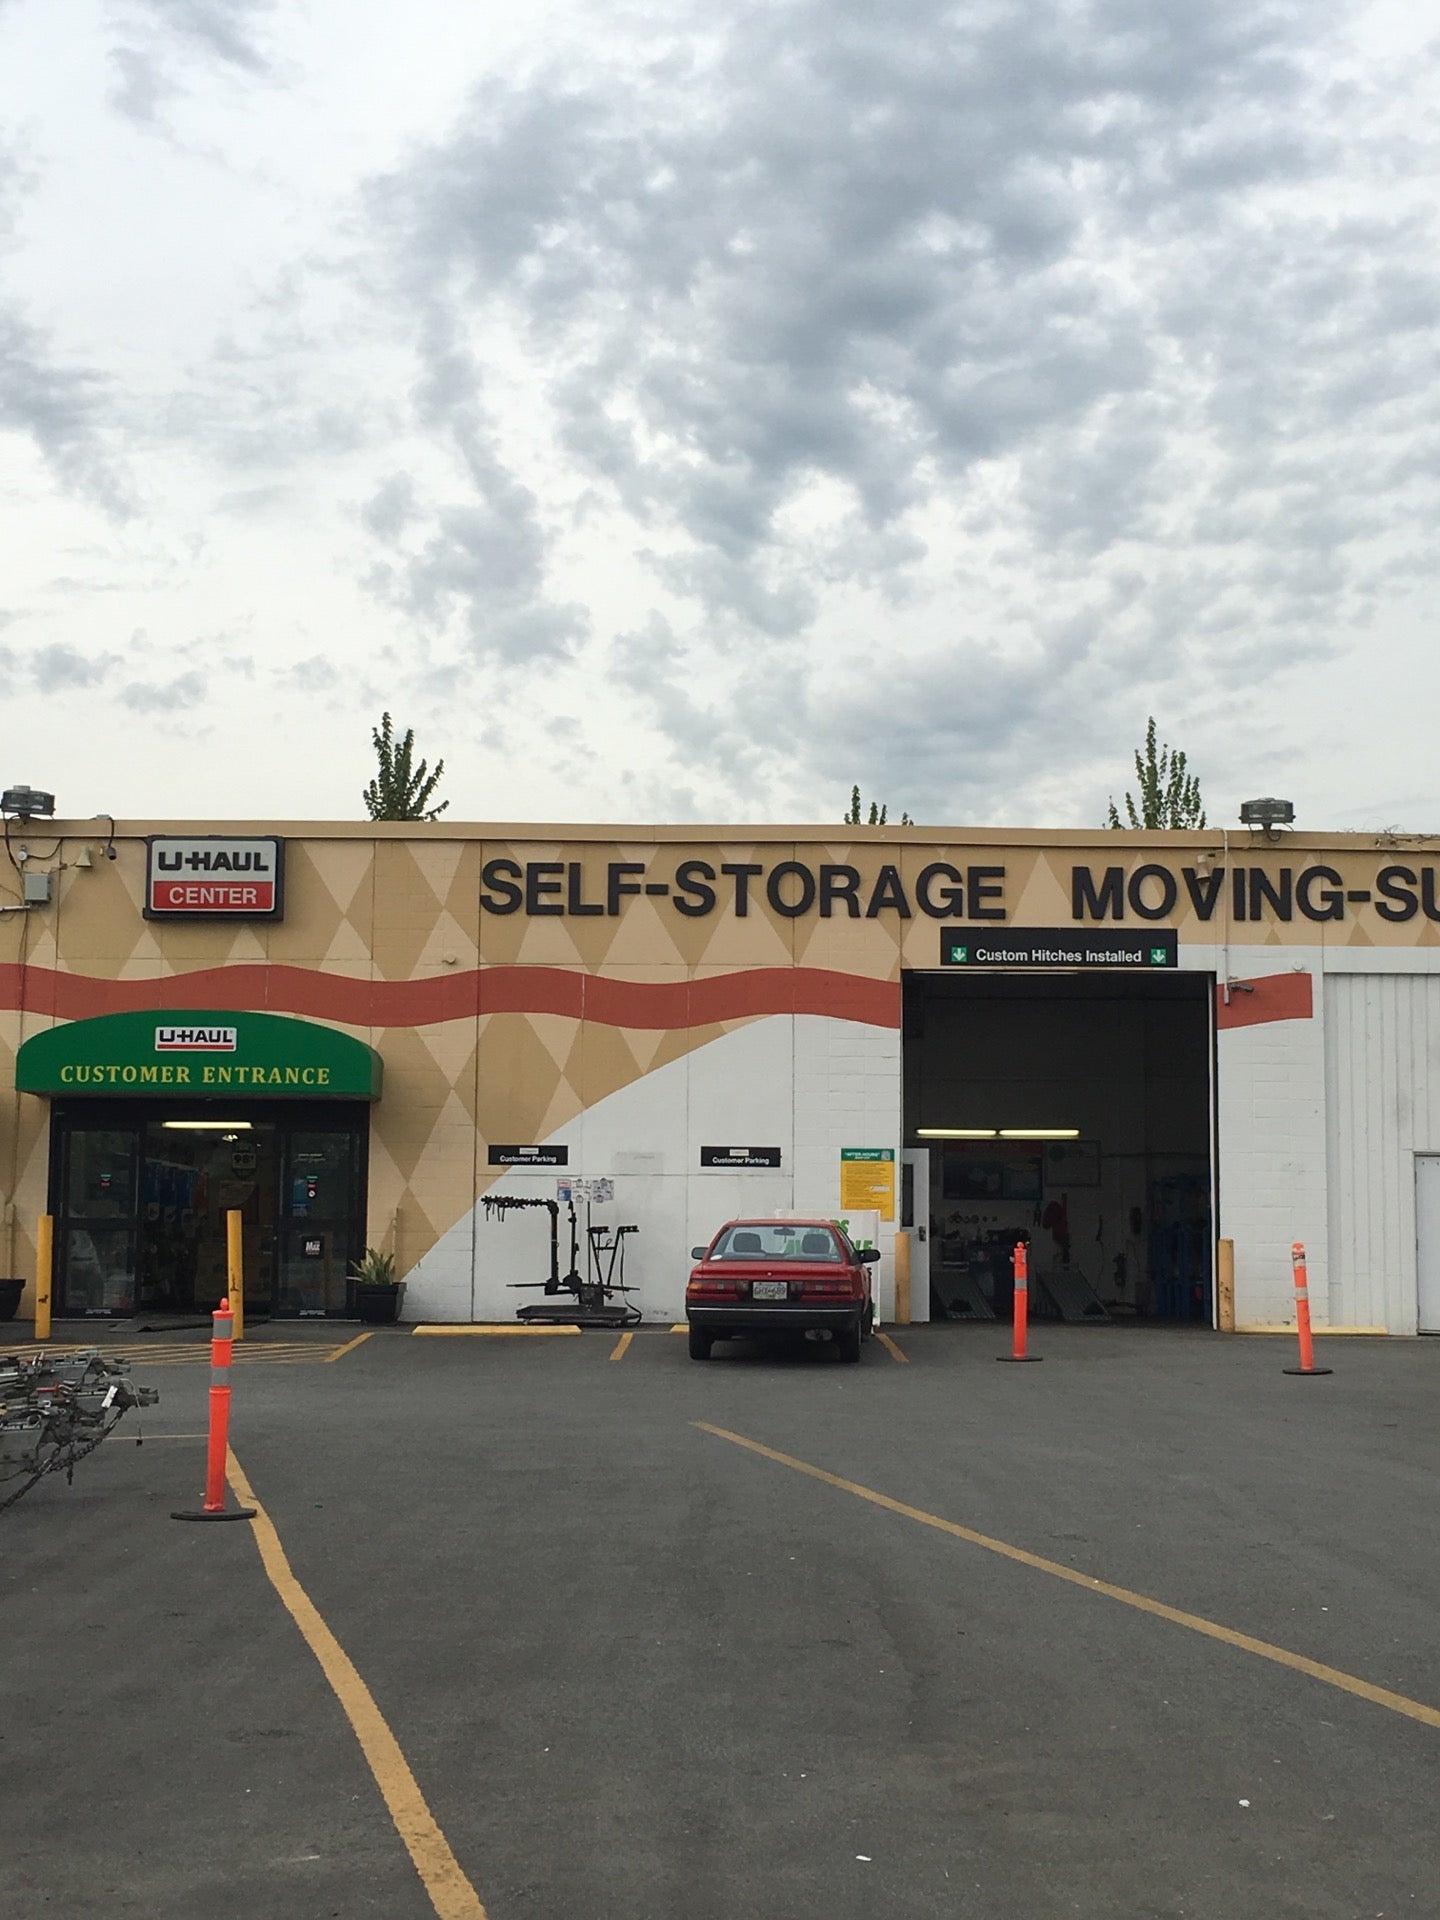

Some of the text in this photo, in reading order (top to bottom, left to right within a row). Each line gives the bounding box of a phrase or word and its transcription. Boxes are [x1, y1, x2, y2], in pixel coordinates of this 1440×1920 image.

[158, 851, 269, 871] U-HAUL
[169, 886, 257, 904] CENTER
[480, 859, 1006, 920] SELF-STORAGE
[976, 949, 1142, 962] Custom Hitches Installed
[159, 1030, 232, 1043] U-HAUL
[60, 1066, 330, 1085] CUSTOMER ENTRANCE
[500, 1155, 531, 1163] Customer
